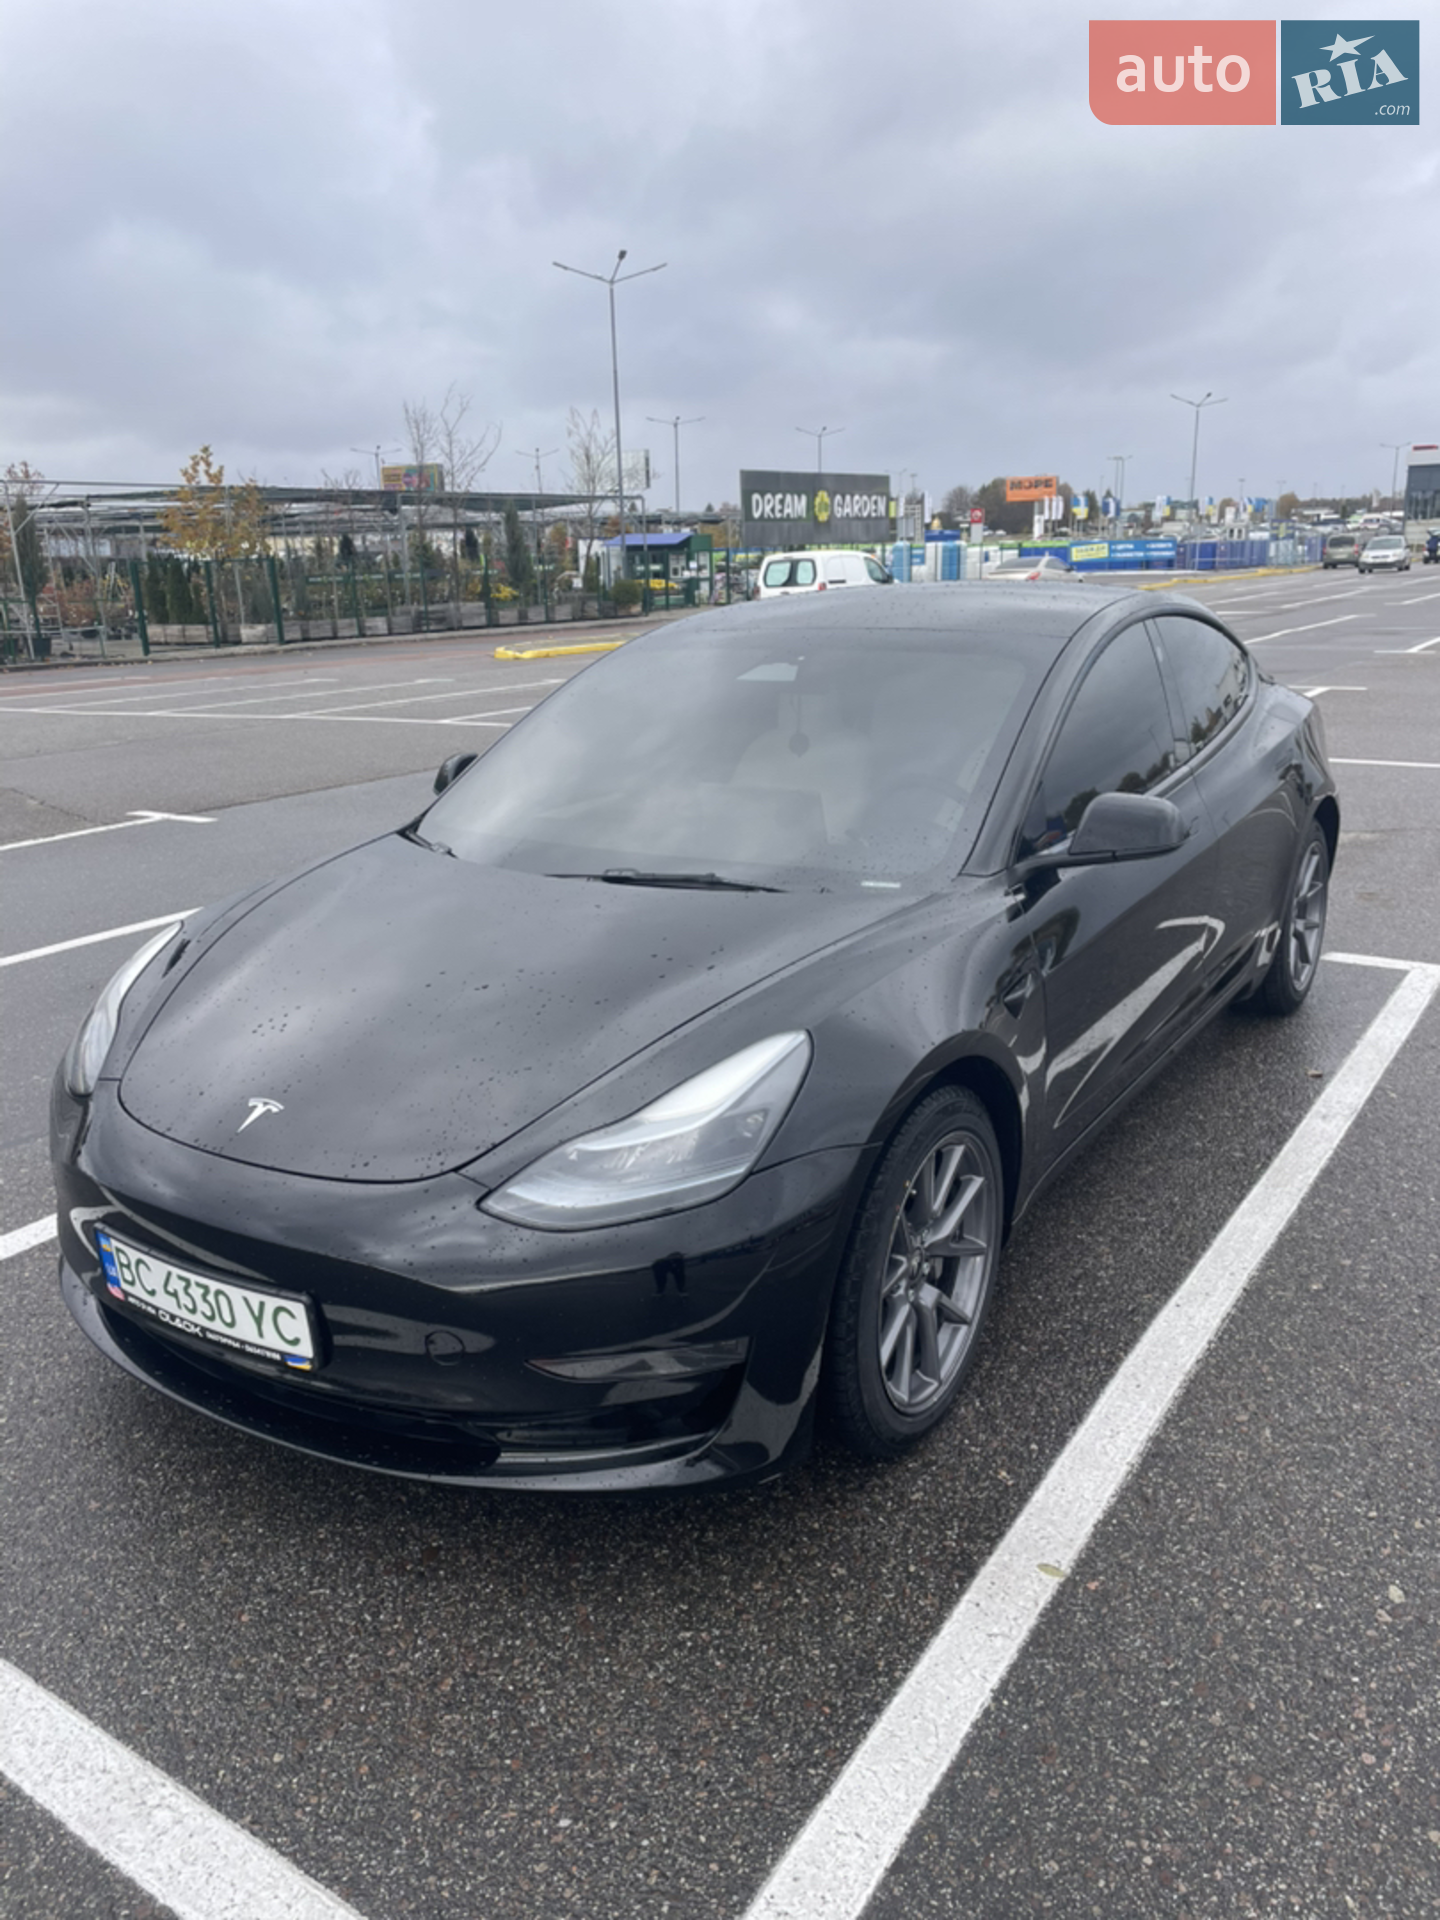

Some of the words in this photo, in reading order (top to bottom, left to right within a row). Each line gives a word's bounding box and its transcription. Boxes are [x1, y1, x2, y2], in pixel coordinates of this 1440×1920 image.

[751, 492, 807, 519] DREAM
[833, 493, 887, 518] GARDEN
[114, 1246, 157, 1297] BC
[162, 1270, 236, 1329] 4330
[242, 1295, 301, 1347] YC
